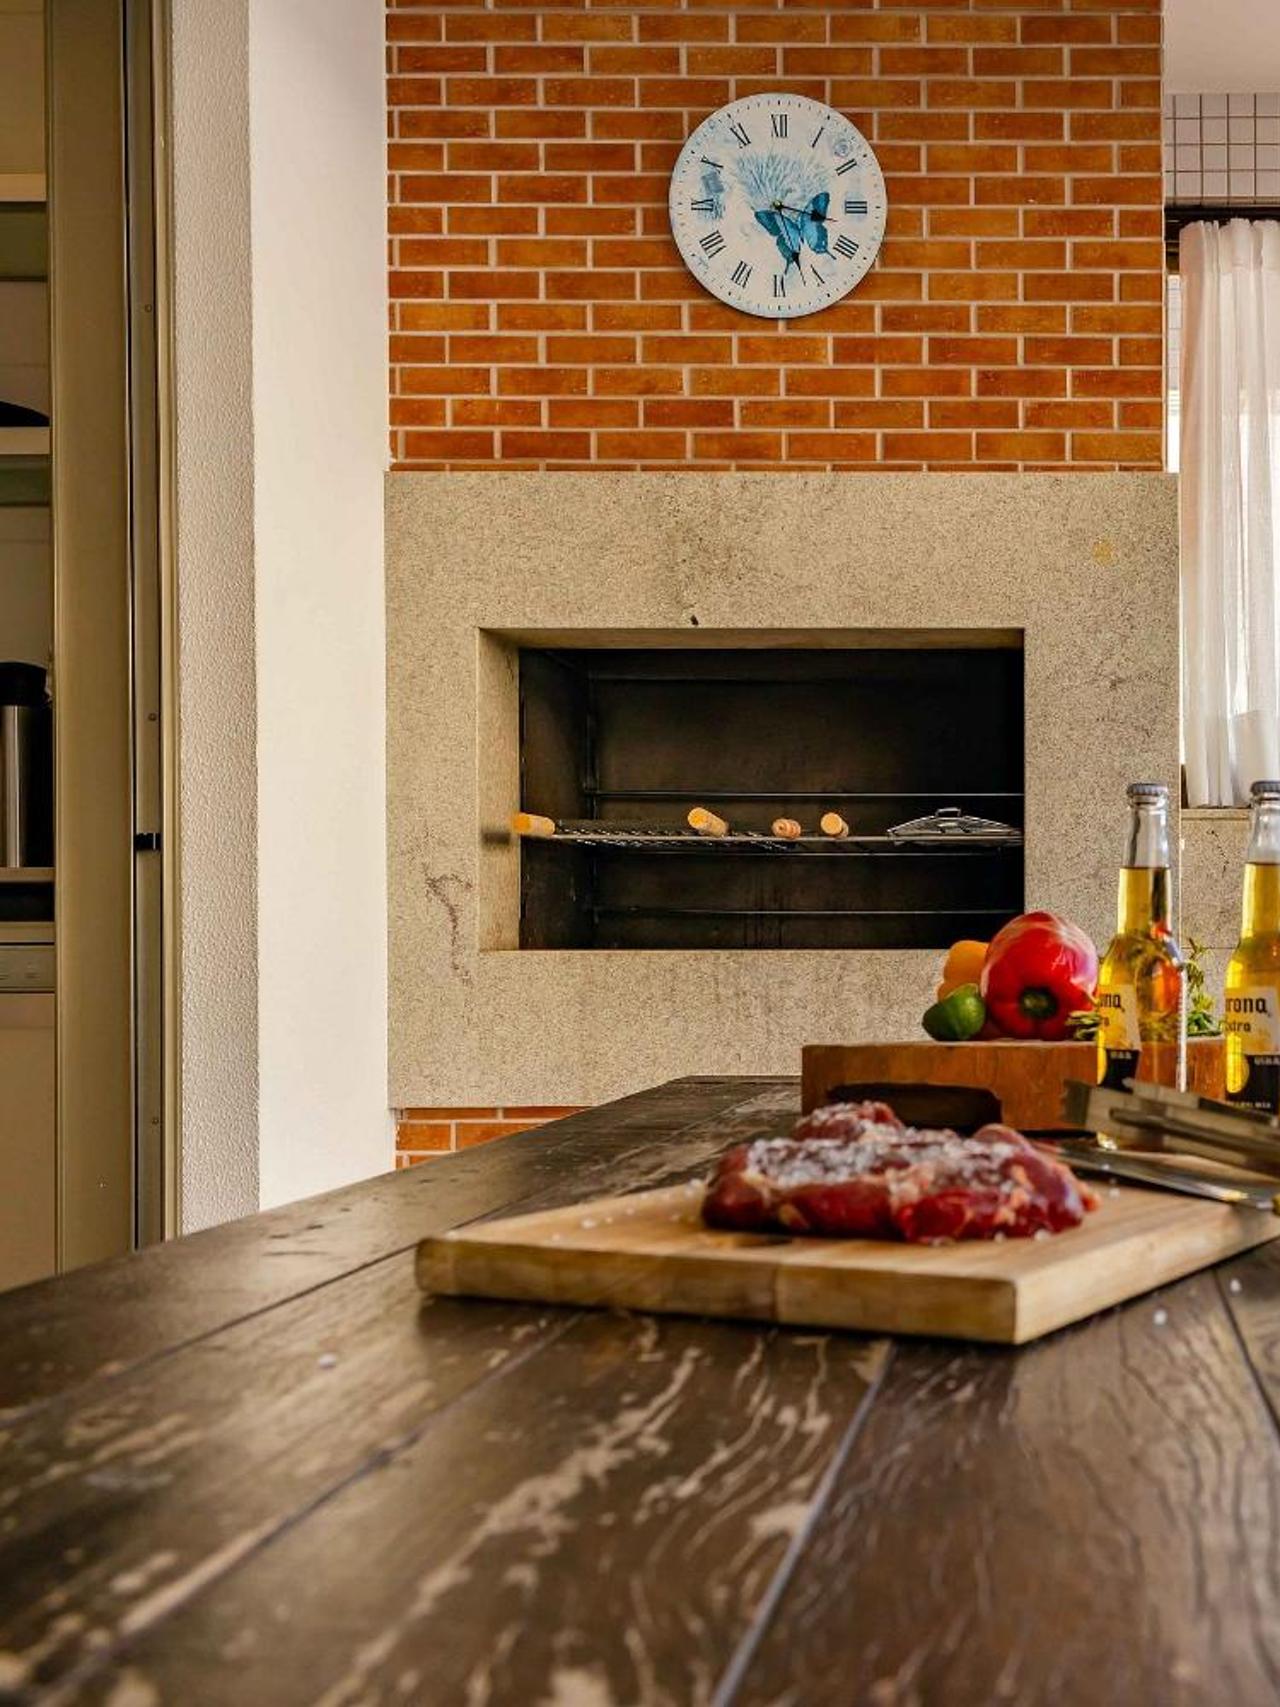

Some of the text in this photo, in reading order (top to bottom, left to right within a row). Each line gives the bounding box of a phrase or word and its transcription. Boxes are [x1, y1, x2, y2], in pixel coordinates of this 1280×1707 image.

[730, 123, 751, 148] XI
[771, 114, 788, 138] XII
[812, 127, 825, 148] I
[701, 155, 724, 173] X
[835, 159, 858, 176] II
[691, 198, 713, 211] IX
[844, 201, 867, 214] III
[699, 230, 727, 259] VIII
[833, 235, 859, 259] IIII
[731, 260, 753, 289] VII
[773, 274, 786, 298] VI
[810, 264, 825, 286] V
